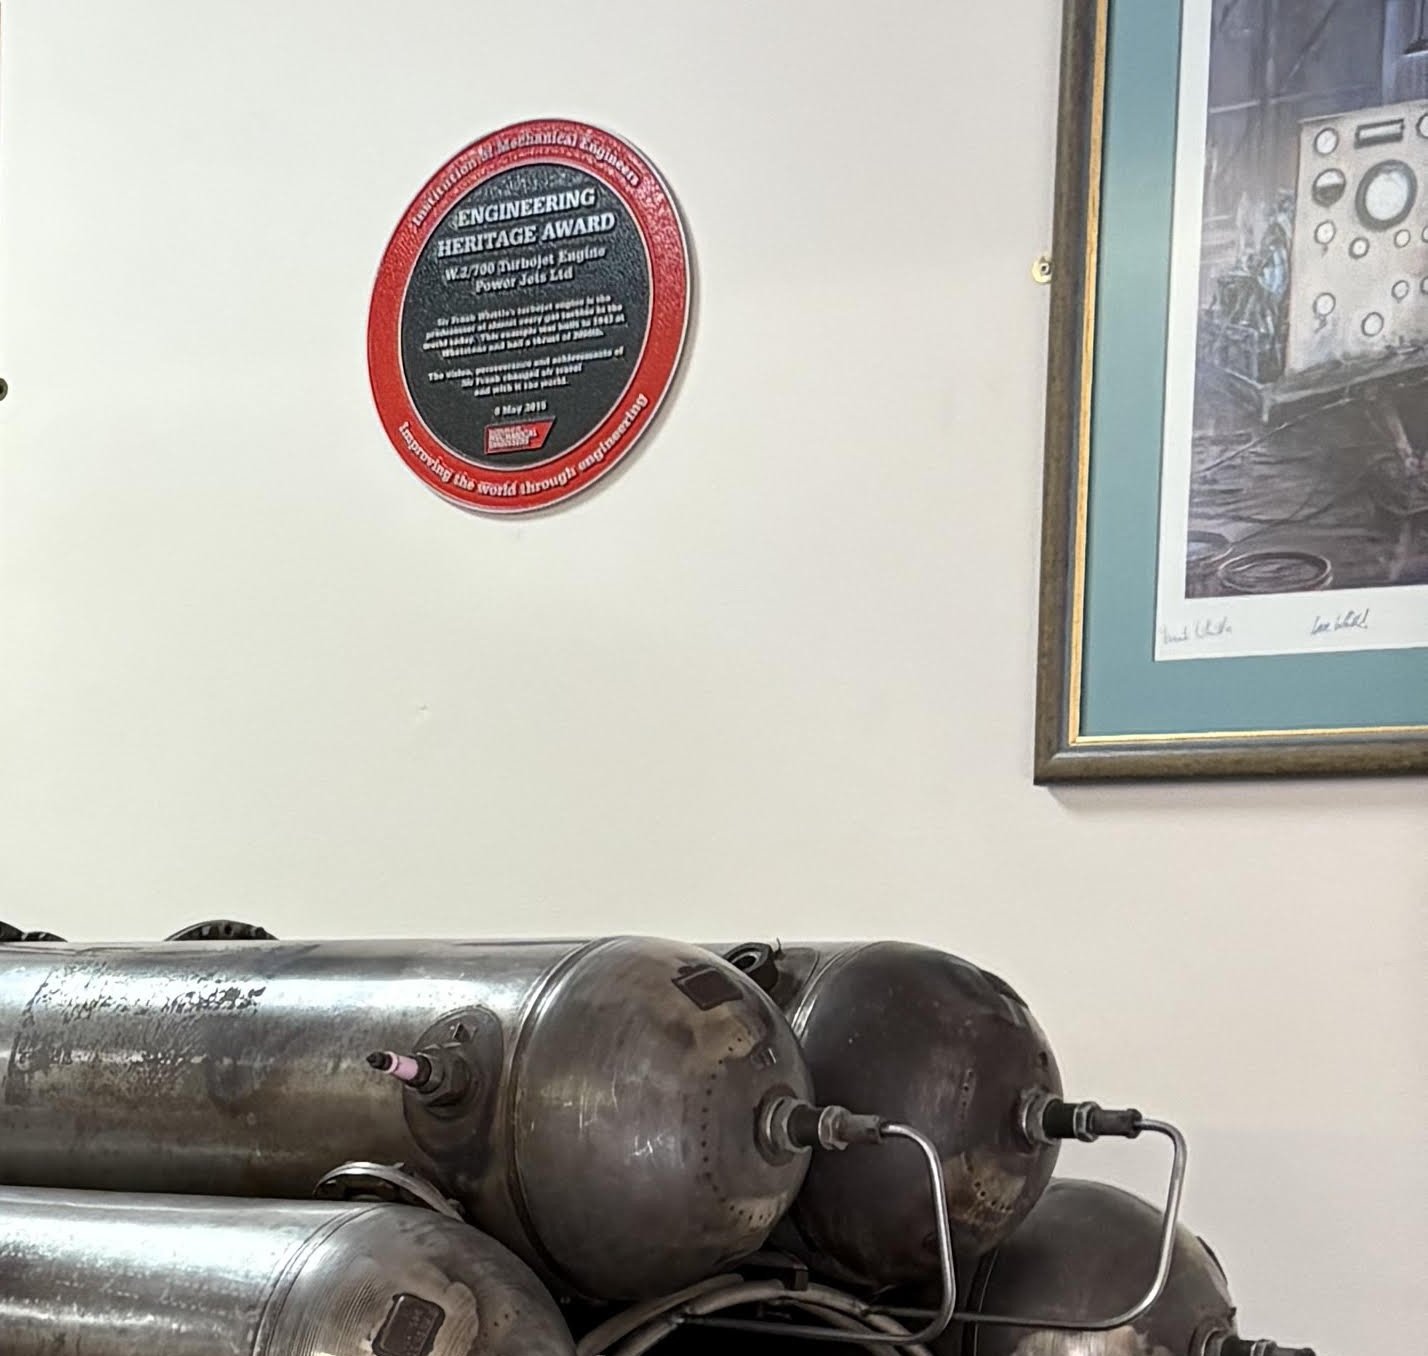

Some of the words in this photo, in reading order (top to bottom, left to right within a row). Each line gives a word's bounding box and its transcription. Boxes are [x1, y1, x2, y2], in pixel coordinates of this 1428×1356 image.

[496, 131, 578, 155] Mechanical
[580, 134, 641, 187] Engineers
[457, 187, 596, 228] ENGINEERING
[437, 225, 537, 258] HERITAGE
[542, 212, 616, 242] AWARD
[475, 276, 516, 294] Power
[519, 270, 547, 287] Jets
[549, 266, 574, 282] Ltd
[497, 253, 555, 275] Turbojet
[558, 246, 607, 266] Engine
[399, 421, 452, 484] Improving
[453, 472, 475, 491] the
[478, 480, 517, 497] world
[519, 466, 577, 496] through
[578, 393, 649, 472] engineering
